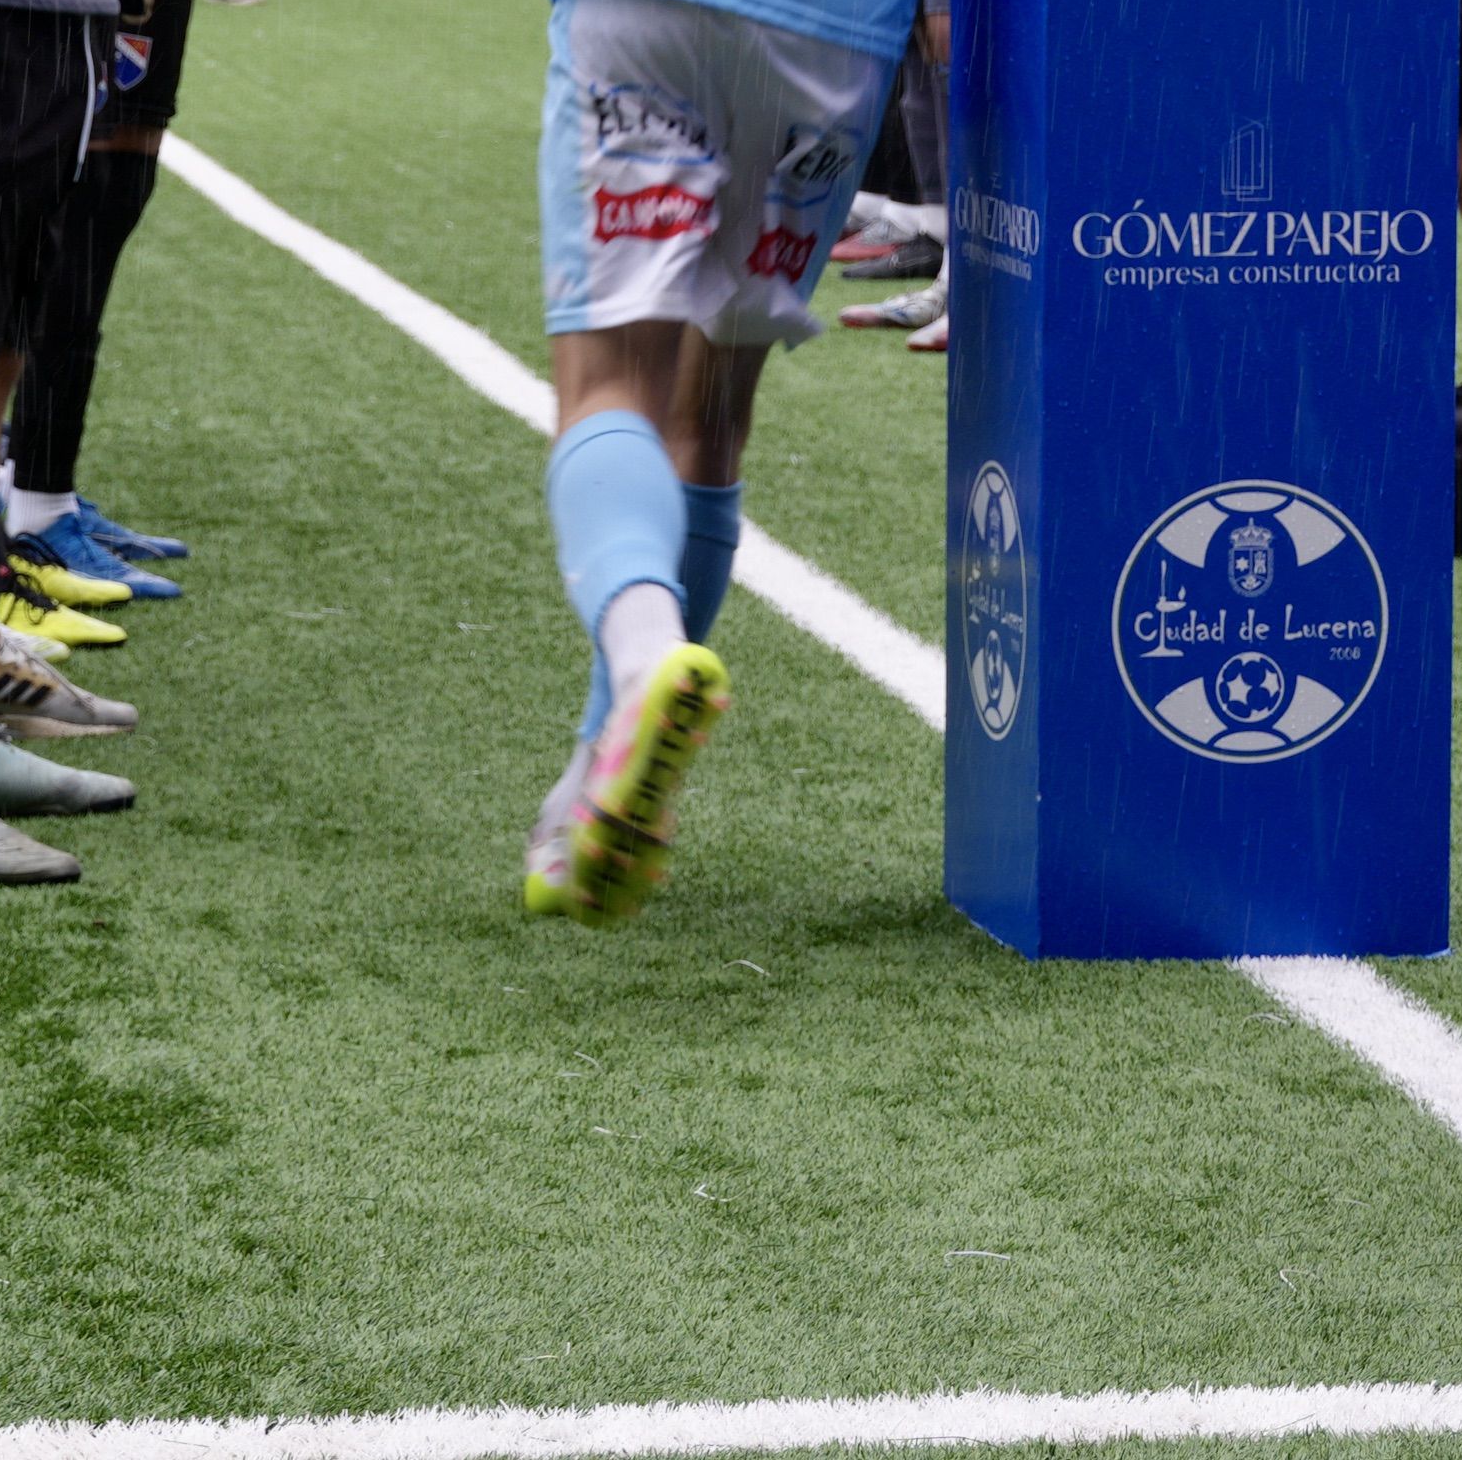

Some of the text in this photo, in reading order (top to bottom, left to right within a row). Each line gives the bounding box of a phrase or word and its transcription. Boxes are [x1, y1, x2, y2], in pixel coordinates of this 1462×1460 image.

[1071, 199, 1434, 264] GÓMEZ PAREJO
[1104, 261, 1401, 291] empresa constructora
[1239, 608, 1271, 643] de
[1284, 603, 1377, 641] Lucena
